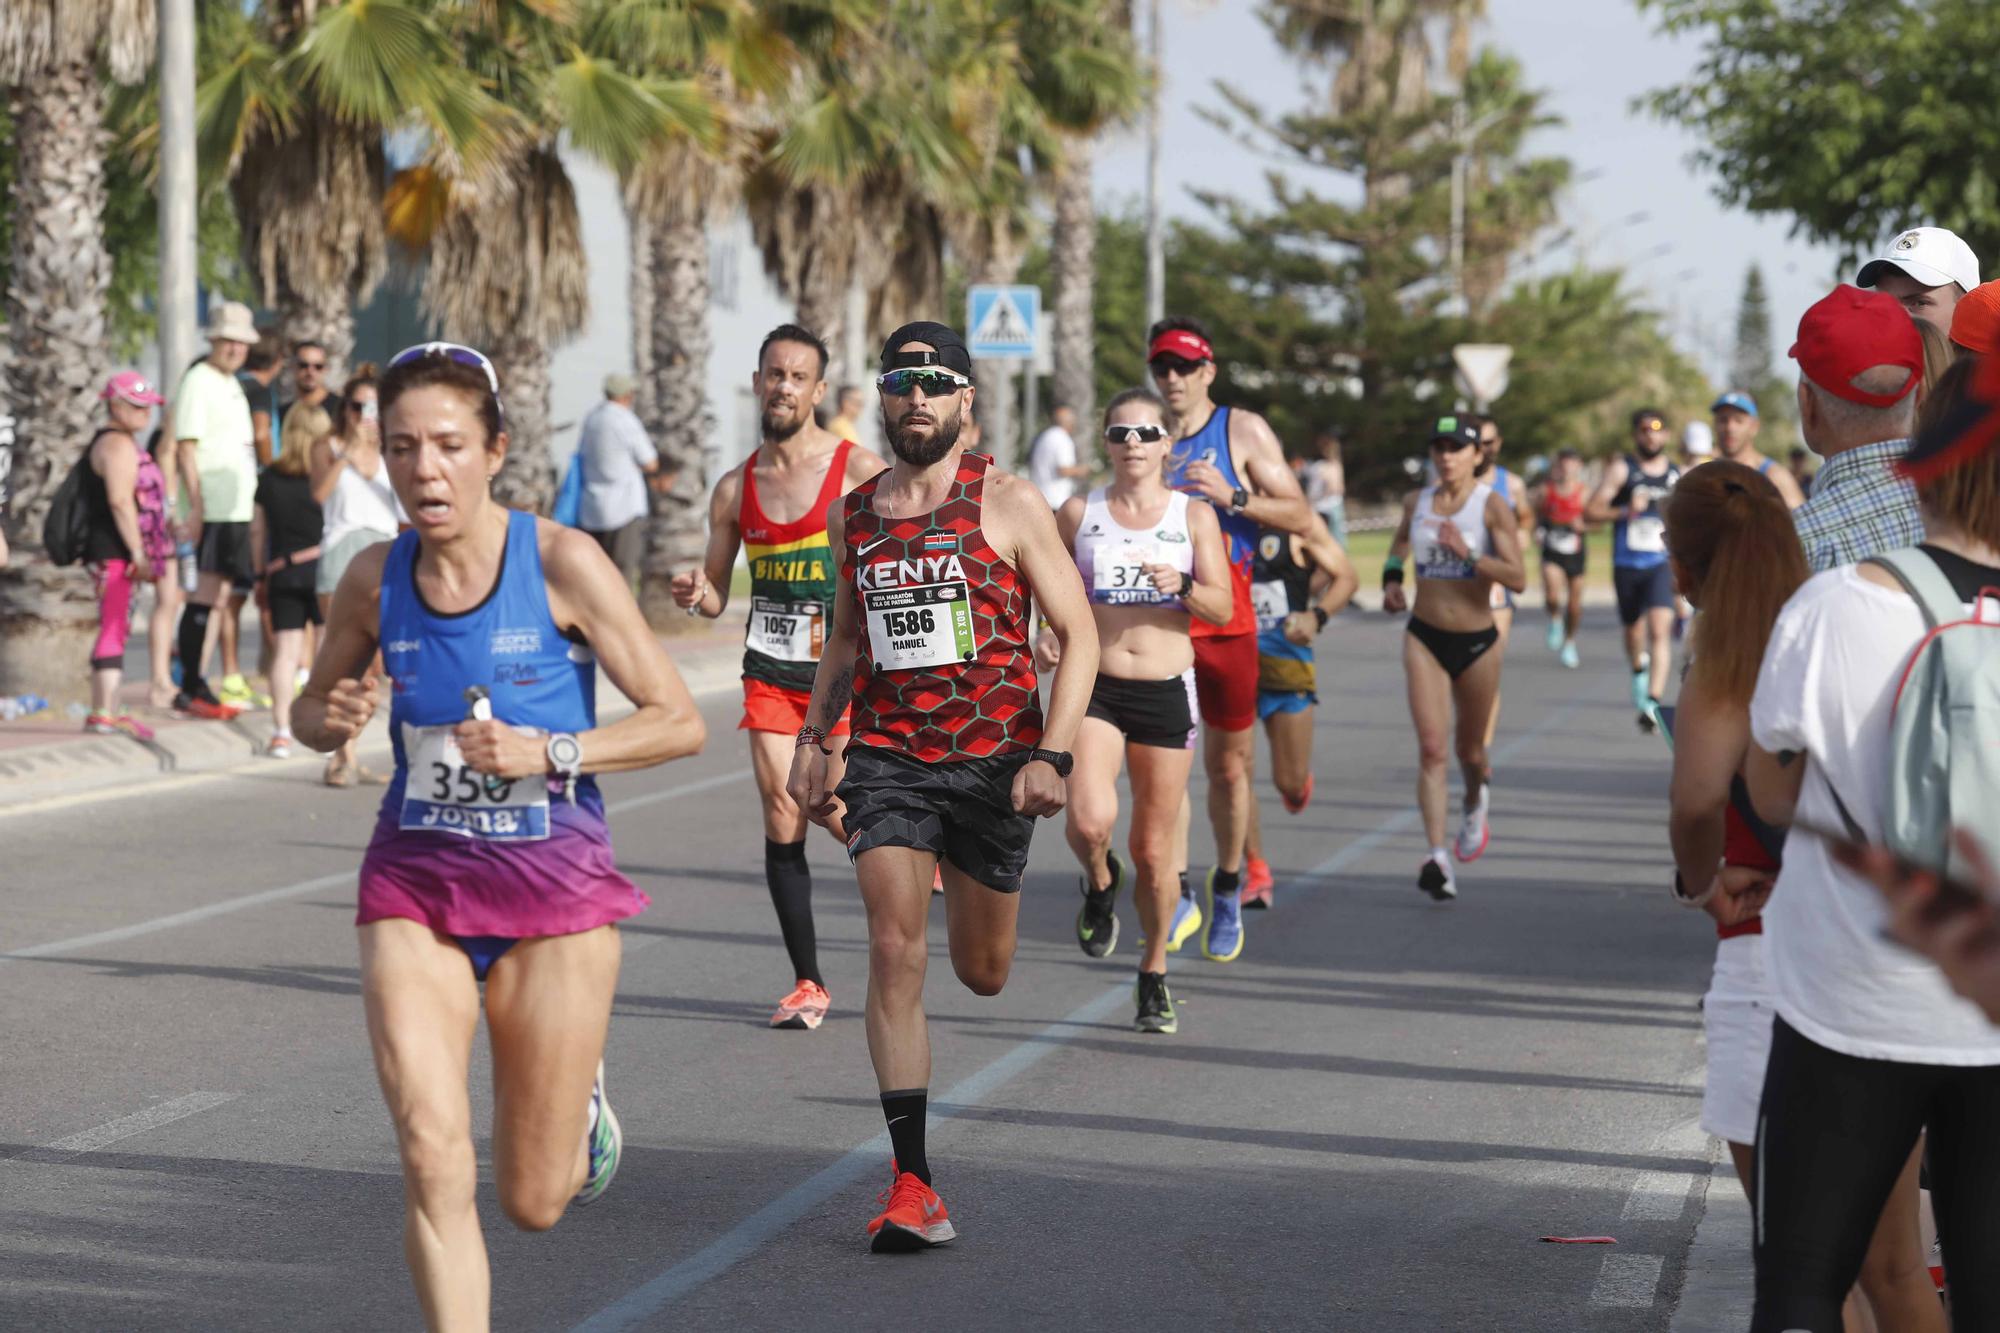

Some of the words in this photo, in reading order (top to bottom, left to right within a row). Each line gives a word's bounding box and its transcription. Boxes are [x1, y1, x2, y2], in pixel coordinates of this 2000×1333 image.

[755, 559, 826, 582] BIKILA
[856, 555, 967, 591] KENYA
[764, 616, 797, 636] 1057
[882, 608, 935, 637] 1586
[956, 610, 967, 627] BOX
[892, 638, 927, 650] MANUEL
